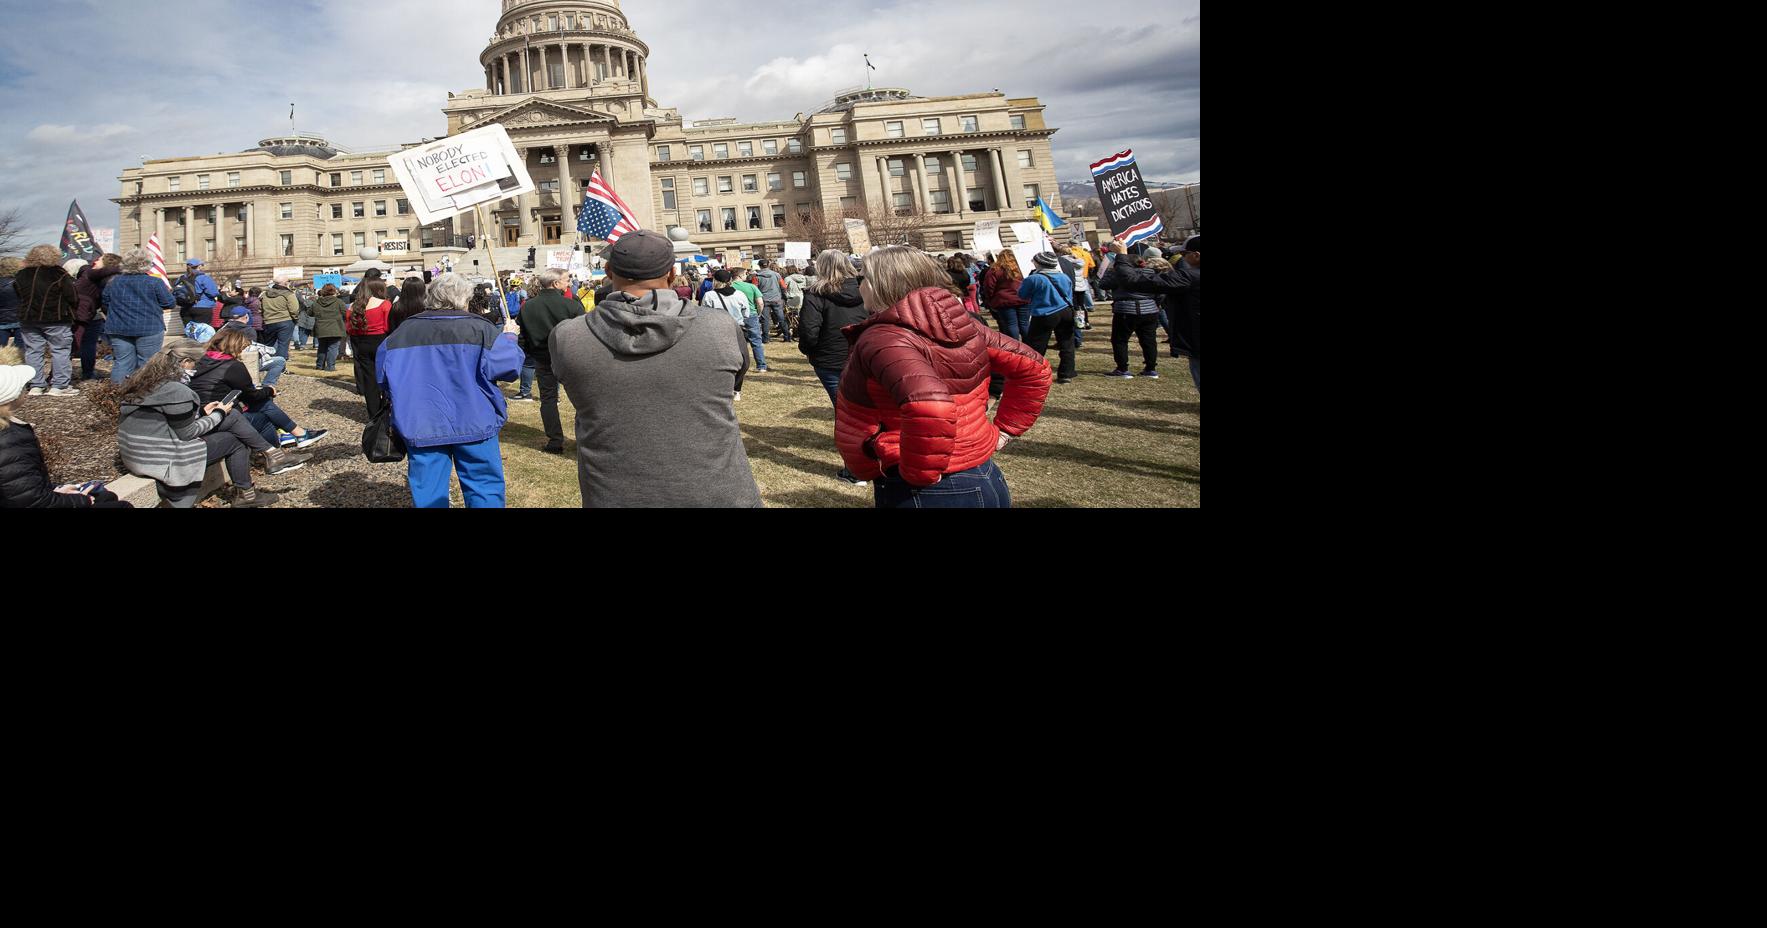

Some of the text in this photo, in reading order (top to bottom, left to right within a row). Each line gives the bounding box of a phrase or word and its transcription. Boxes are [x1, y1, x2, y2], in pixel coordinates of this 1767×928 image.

[417, 144, 463, 169] NOBODY
[436, 151, 488, 174] ELECTED
[1102, 169, 1139, 194] AMERICA
[1110, 185, 1140, 206] HATES
[1111, 198, 1152, 222] DICTATORS
[384, 241, 407, 251] RESIST
